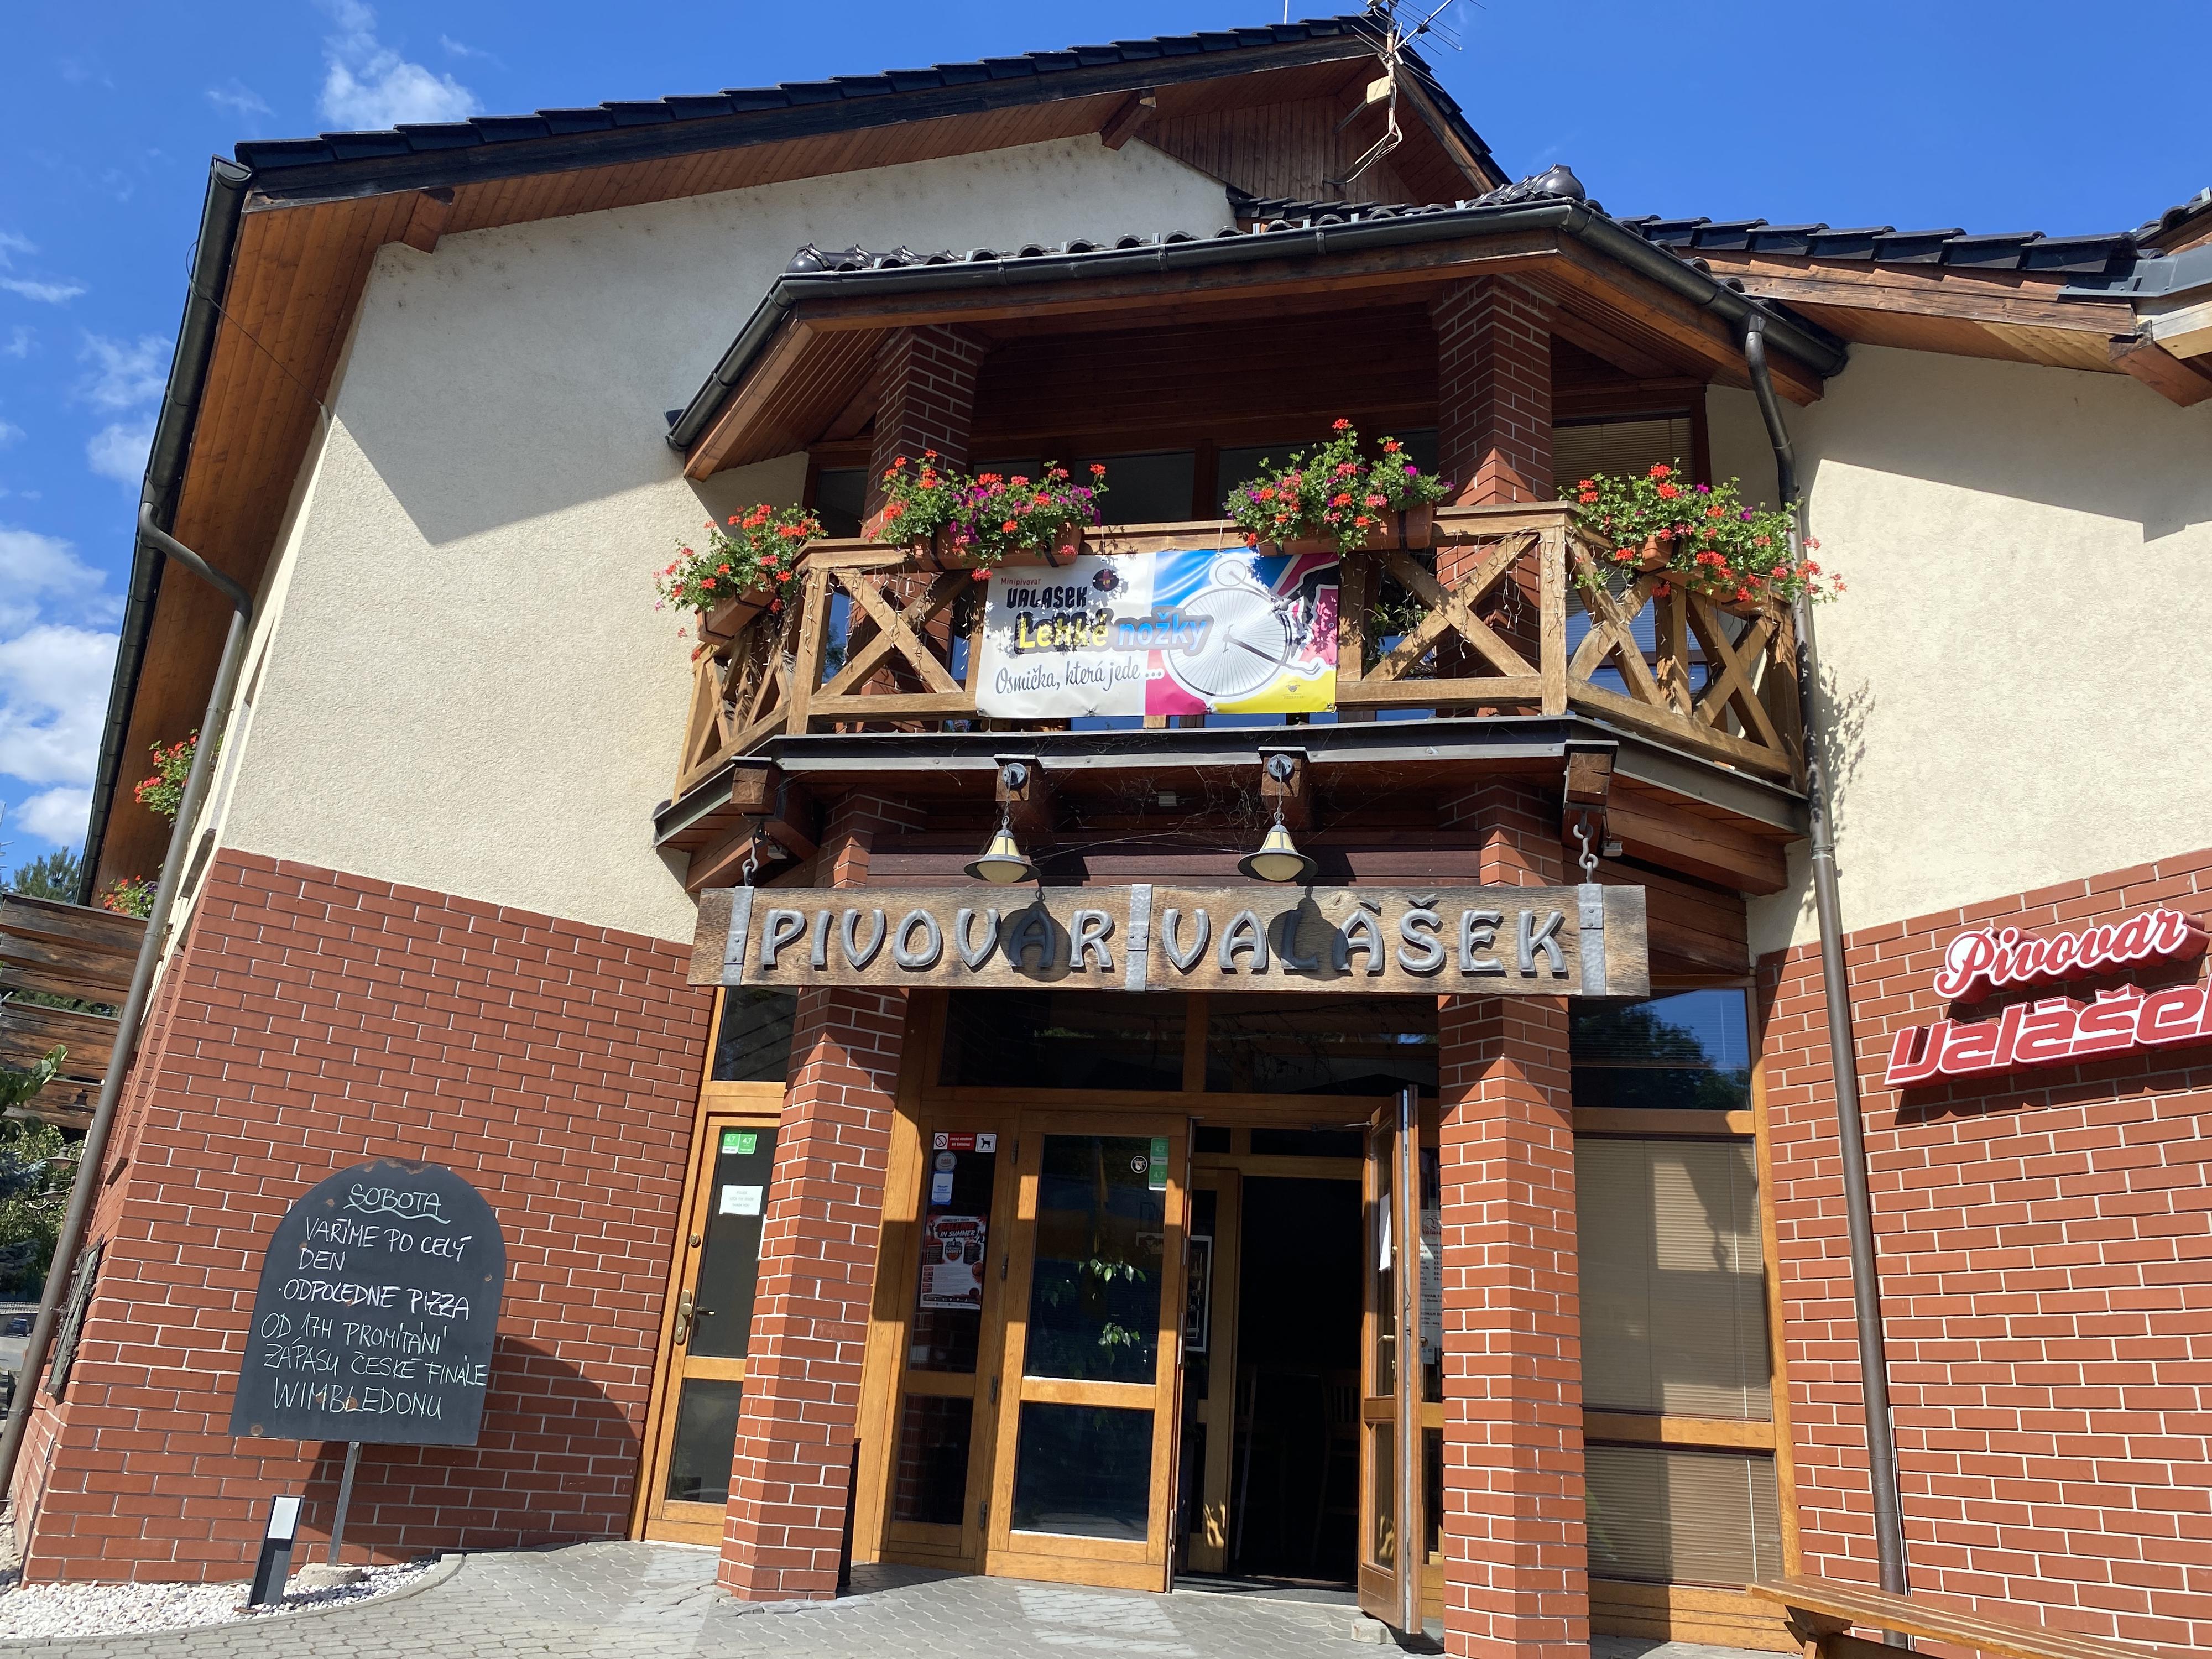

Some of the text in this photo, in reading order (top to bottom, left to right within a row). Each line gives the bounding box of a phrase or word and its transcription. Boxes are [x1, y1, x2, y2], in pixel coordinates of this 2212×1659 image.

[1000, 577, 1041, 586] Minipivovar
[1019, 612, 1207, 650] Lehké nožky
[996, 665, 1060, 695] Osmička,
[1066, 661, 1105, 686] která
[761, 909, 1114, 968] PIVOVAR
[1933, 907, 2189, 999] Pivovar
[349, 1183, 442, 1216] SOBOTA
[383, 1228, 413, 1253] PO
[298, 1247, 346, 1271] DEN
[406, 1288, 470, 1321] PIZZA
[260, 1312, 291, 1339] OD
[301, 1312, 333, 1339] 17H
[274, 1377, 442, 1420] WIMBLEDONU
